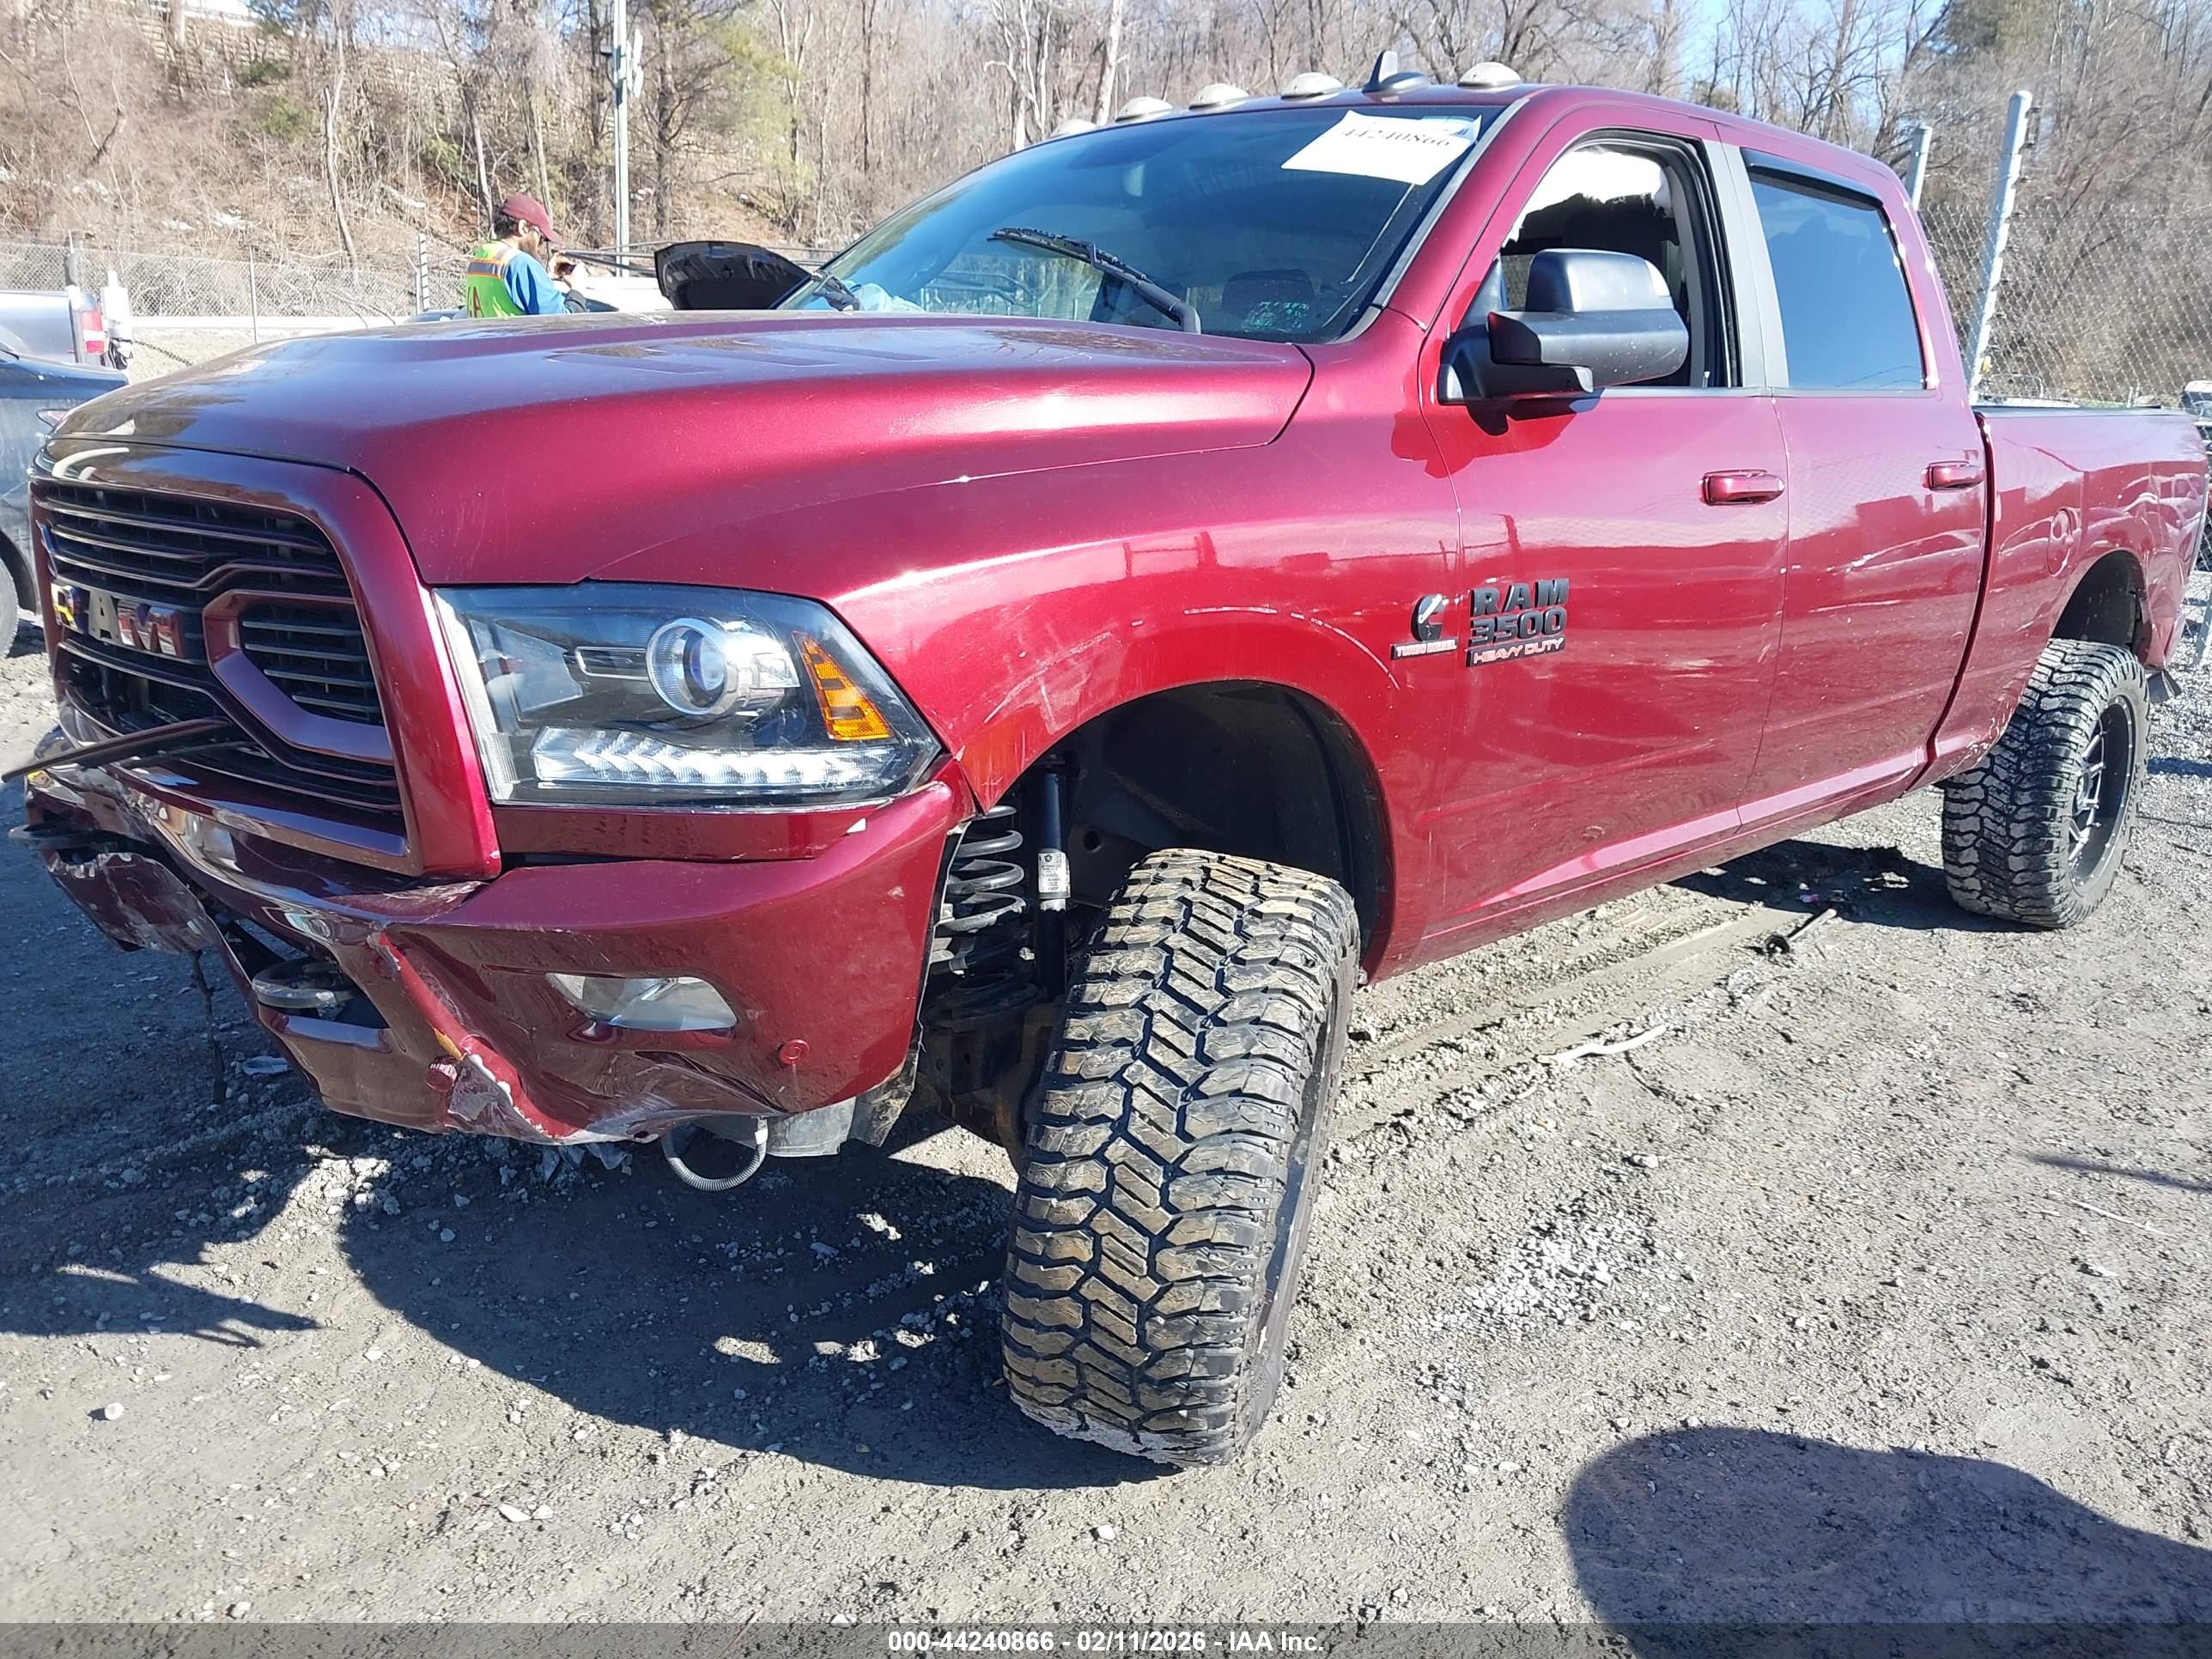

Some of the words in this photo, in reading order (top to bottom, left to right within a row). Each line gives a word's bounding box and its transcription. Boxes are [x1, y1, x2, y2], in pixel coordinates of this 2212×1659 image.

[1470, 578, 1570, 617] RAM
[51, 583, 185, 659] RAM
[1469, 606, 1567, 646] 3500
[1474, 643, 1523, 664] HEAVY
[1524, 637, 1565, 655] DUTY
